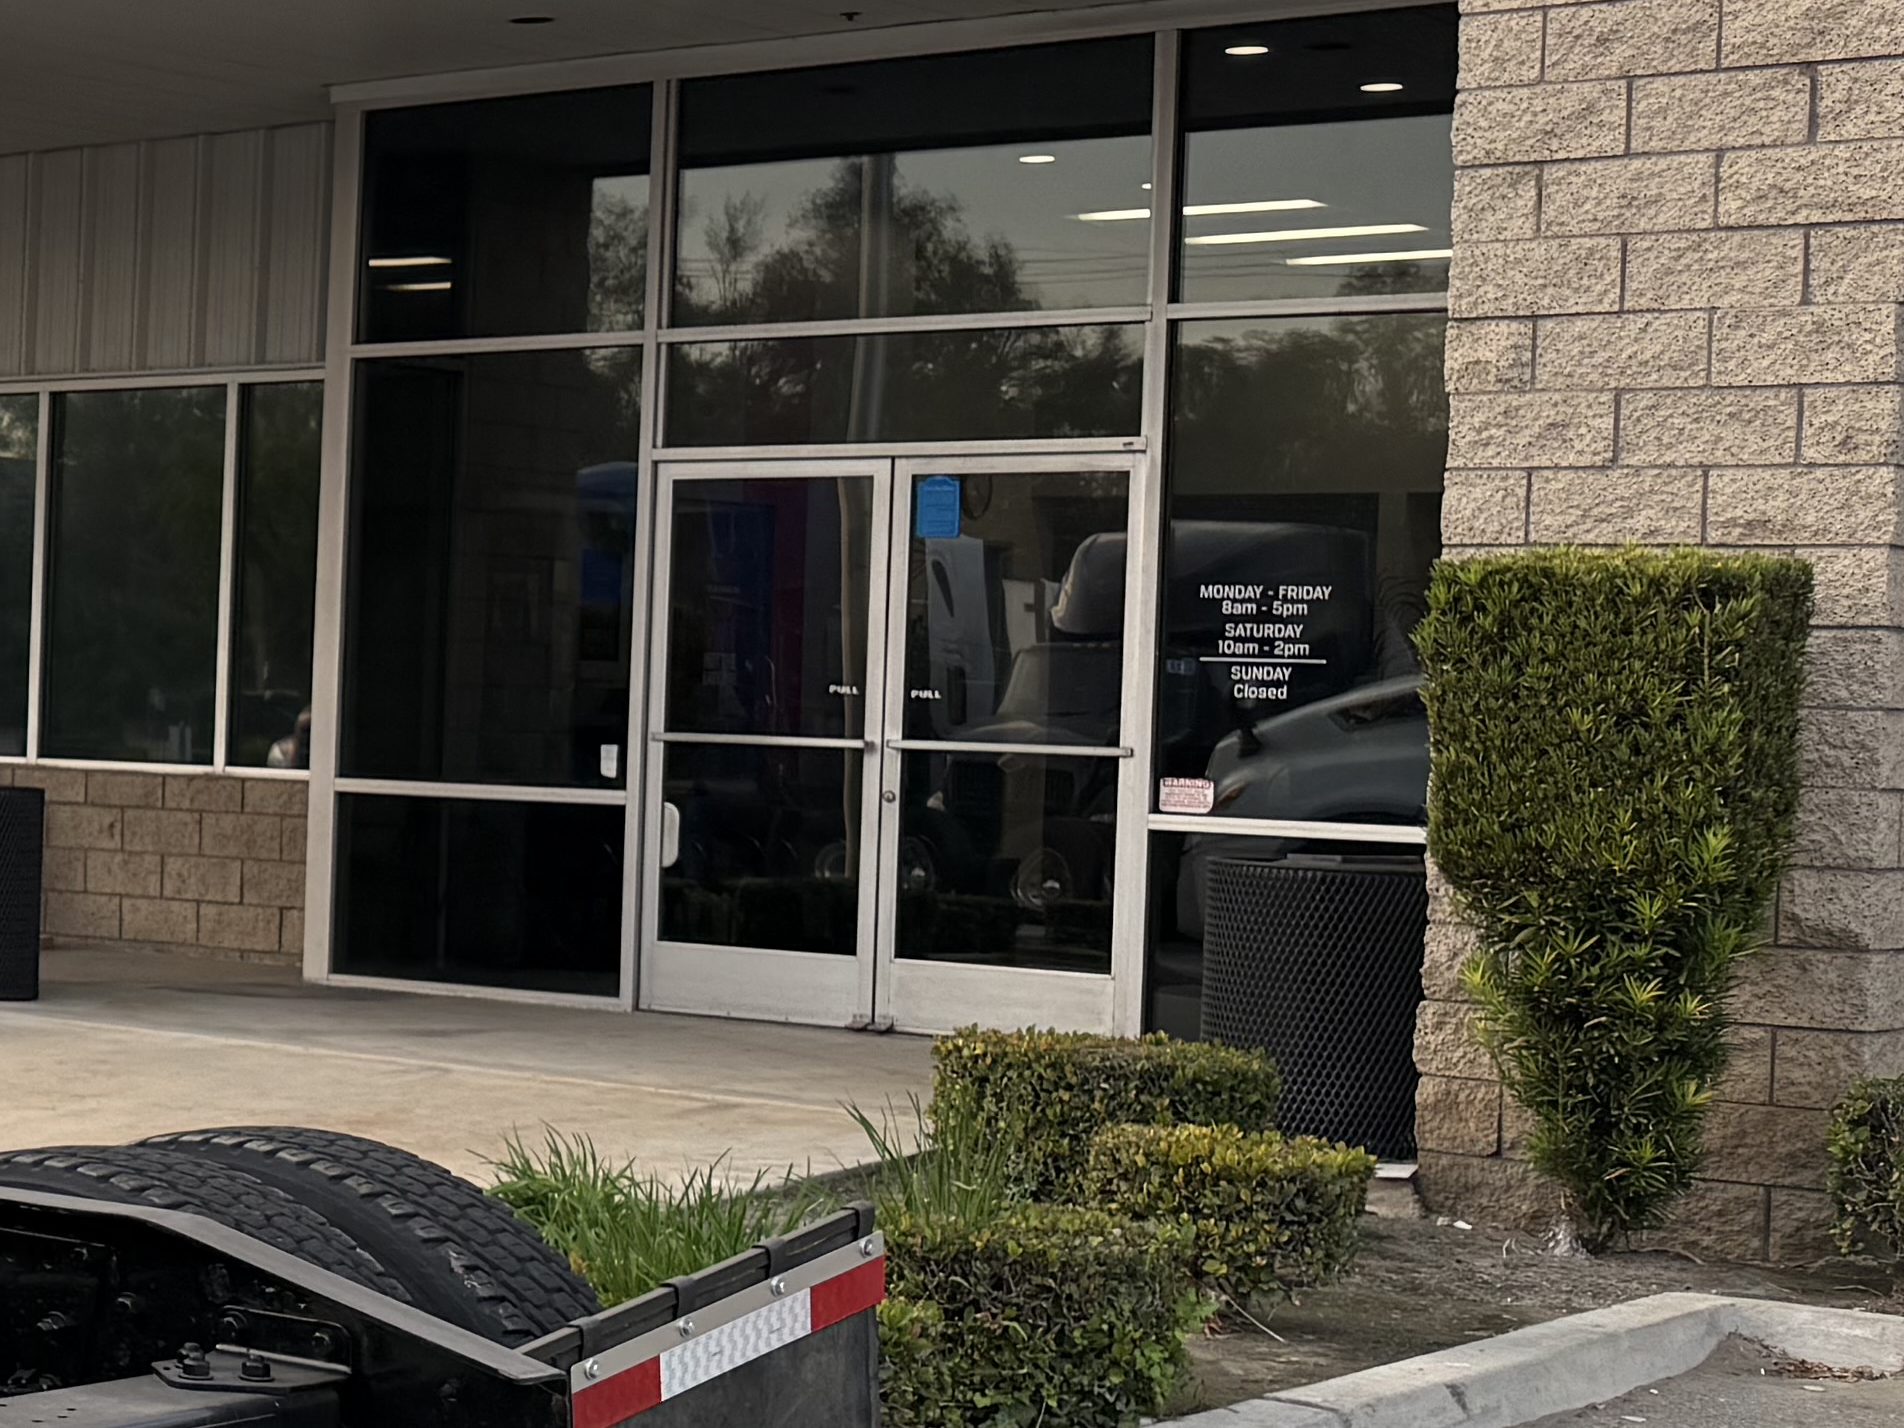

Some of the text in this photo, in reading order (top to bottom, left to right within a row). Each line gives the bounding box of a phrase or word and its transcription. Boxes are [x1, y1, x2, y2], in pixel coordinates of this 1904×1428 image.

[1199, 584, 1264, 599] MONDAY
[1278, 585, 1332, 600] FRIDAY
[1221, 601, 1257, 615] 8am
[1272, 601, 1308, 618] 5pm
[1224, 623, 1304, 638] SATURDAY
[1217, 640, 1259, 655] 10am
[1273, 640, 1310, 657] 2pm
[1230, 665, 1292, 681] SUNDAY
[829, 684, 859, 695] PULL
[910, 689, 941, 699] PULL
[1233, 684, 1288, 700] Closed
